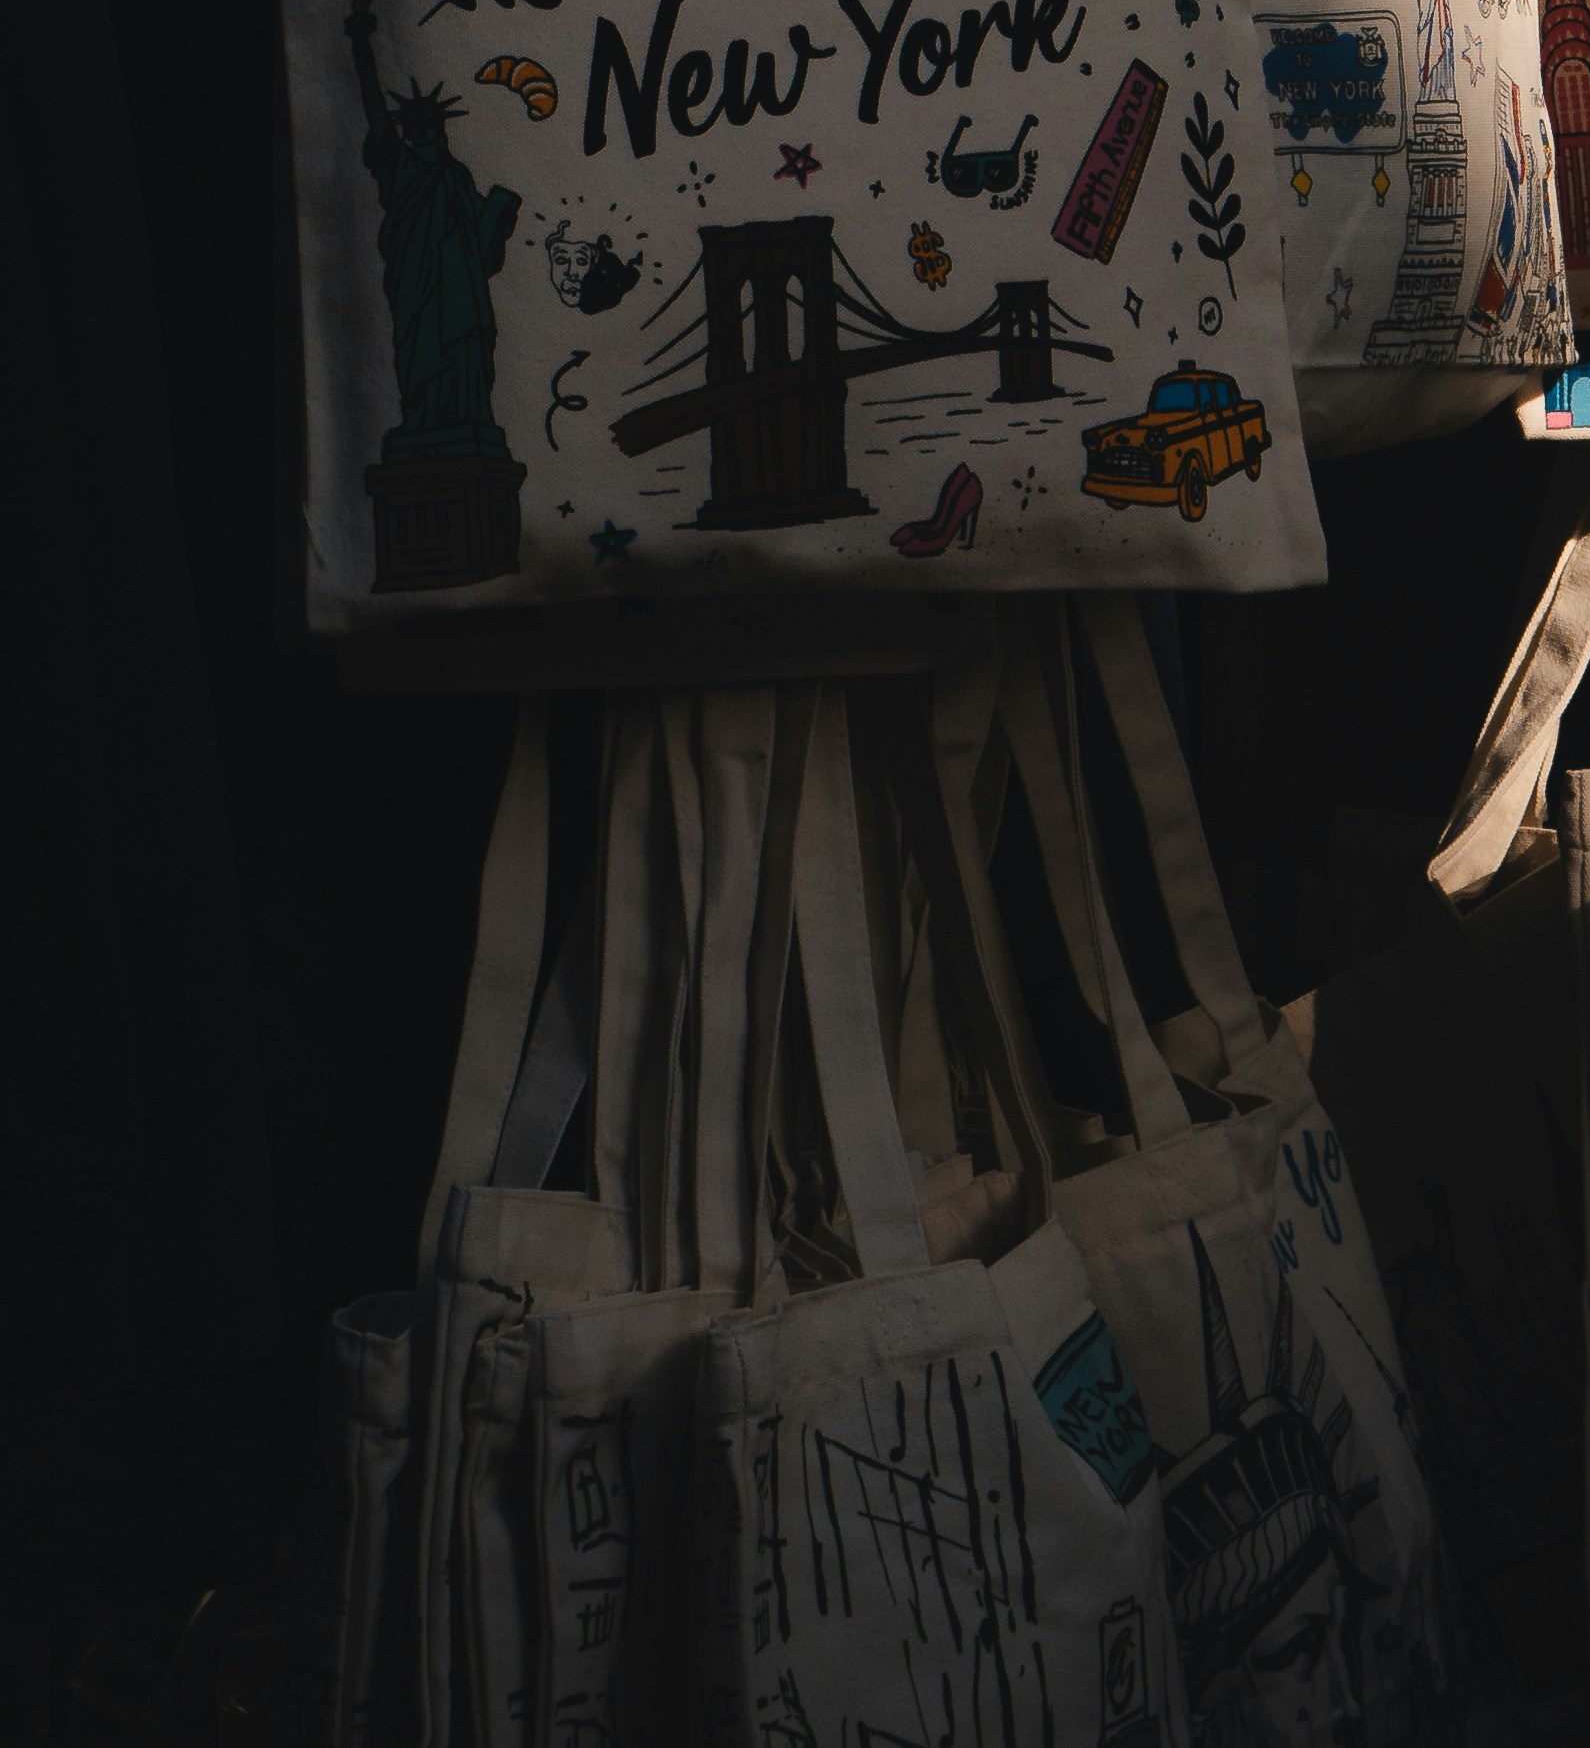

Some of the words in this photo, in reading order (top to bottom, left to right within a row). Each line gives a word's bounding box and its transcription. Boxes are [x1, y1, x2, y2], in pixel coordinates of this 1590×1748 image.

[1269, 27, 1336, 46] WELCOME
[1277, 82, 1318, 103] NEW
[1328, 78, 1387, 102] YORK
[1099, 78, 1148, 169] Avenue
[1357, 110, 1397, 128] State
[1055, 1343, 1124, 1443] NEW
